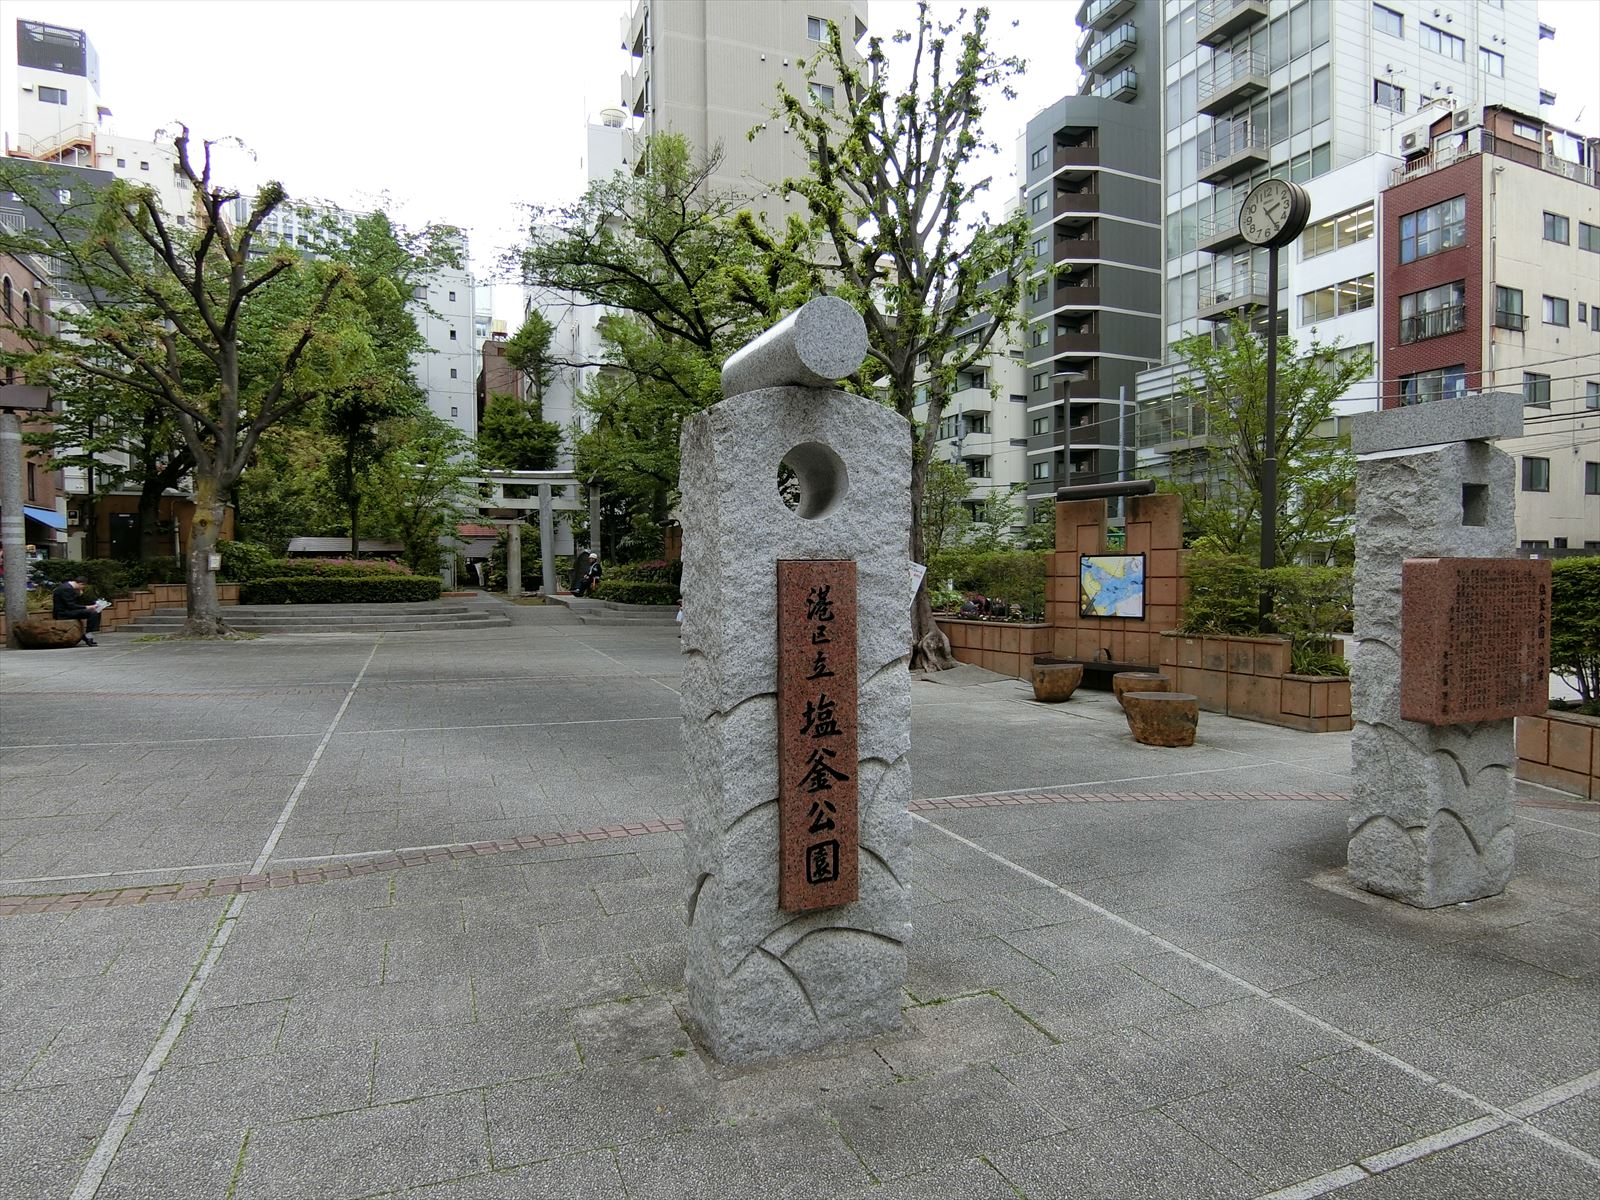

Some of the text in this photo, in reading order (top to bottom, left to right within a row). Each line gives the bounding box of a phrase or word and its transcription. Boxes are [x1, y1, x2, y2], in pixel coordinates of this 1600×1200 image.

[1264, 187, 1272, 198] 12
[1281, 190, 1287, 200] 2
[1254, 193, 1263, 204] 11
[1283, 200, 1289, 209] 3
[1247, 204, 1257, 215] 10
[1280, 211, 1287, 219] 4
[1246, 216, 1252, 225] 9
[1250, 224, 1255, 233] 8
[1265, 228, 1270, 237] 6
[1257, 229, 1262, 238] 7
